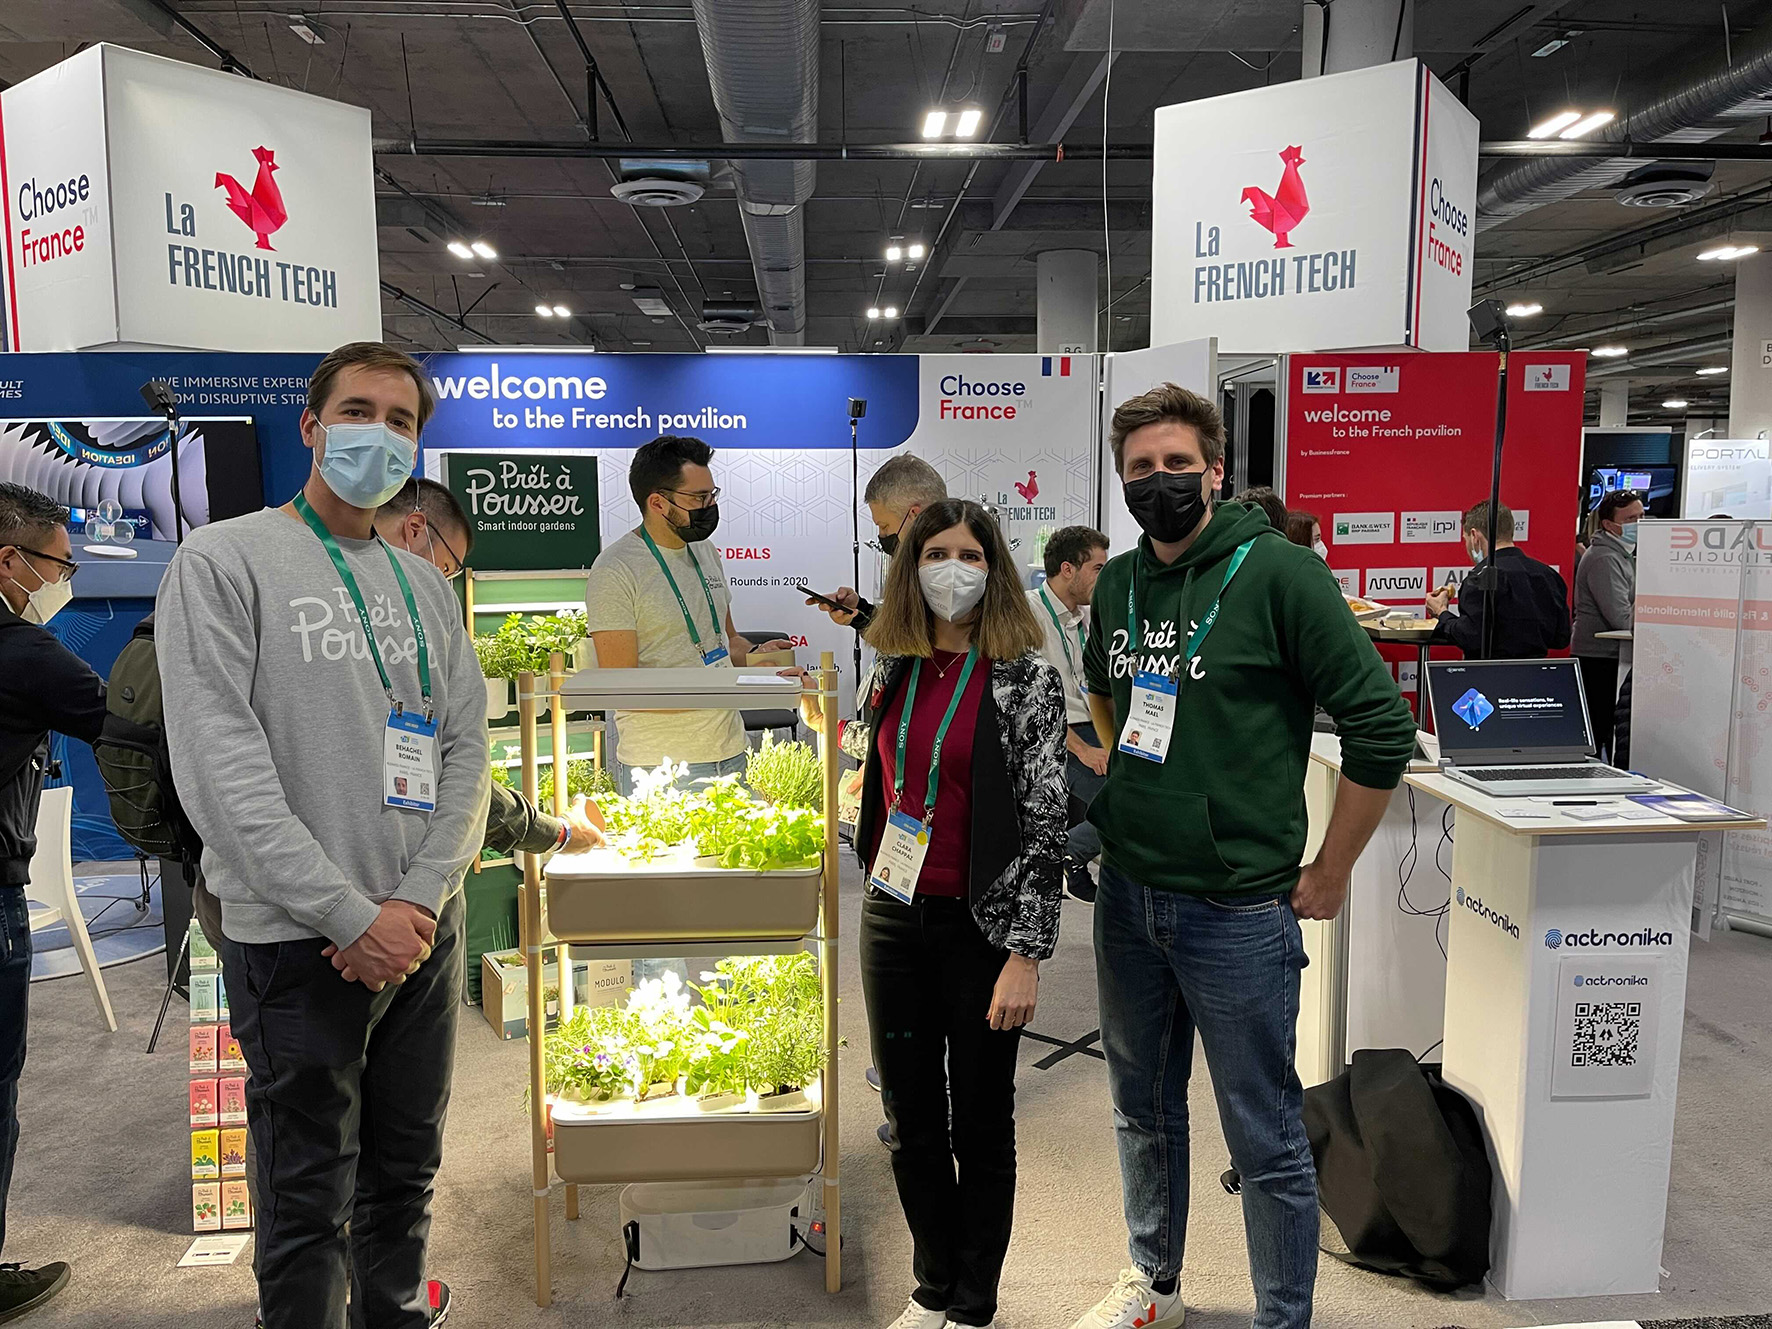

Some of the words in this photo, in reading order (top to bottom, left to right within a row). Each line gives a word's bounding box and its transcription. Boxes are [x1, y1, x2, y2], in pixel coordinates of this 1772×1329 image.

[19, 173, 90, 222] Choose
[1430, 177, 1468, 237] Choose
[165, 192, 196, 237] La
[21, 225, 85, 268] France
[1195, 221, 1220, 258] La
[1428, 221, 1462, 276] France
[168, 243, 272, 298] FRENCH
[276, 261, 338, 308] TECH
[1194, 258, 1286, 303] FRENCH
[1293, 249, 1356, 294] TECH
[184, 377, 259, 388] IMMERSIVE
[263, 377, 312, 388] EXPERI
[432, 363, 607, 400] welcome
[940, 375, 1026, 397] Choose
[199, 393, 277, 405] DISRUPTIVE
[281, 394, 309, 405] STA
[940, 399, 1016, 421] France
[493, 408, 518, 430] to
[524, 406, 565, 430] the
[571, 406, 651, 430] French
[658, 406, 747, 434] pavilion
[1304, 403, 1391, 422] welcome
[1333, 426, 1346, 437] to
[1349, 425, 1369, 437] the
[1372, 425, 1412, 437] French
[1415, 424, 1461, 439] pavilion
[1691, 449, 1766, 459] PORTAL
[555, 465, 573, 490] à
[465, 468, 584, 516] Pousser
[998, 492, 1008, 504] La
[1034, 507, 1056, 520] TECH
[477, 521, 505, 531] Smart
[508, 520, 537, 531] indoor
[540, 521, 576, 533] gardens
[1433, 520, 1455, 534] inpi
[726, 548, 771, 560] DEALS
[730, 576, 769, 587] Rounds
[771, 576, 780, 586] in
[783, 576, 808, 587] 2020
[1205, 599, 1220, 625] SON
[359, 608, 374, 641] SONY
[413, 617, 425, 648] SONY
[1142, 701, 1164, 712] THOMAS
[898, 721, 908, 750] SONY
[398, 752, 420, 763] ROMAIN
[932, 736, 942, 767] SONY
[1466, 894, 1520, 940] actronika
[1565, 928, 1673, 947] actronika
[594, 976, 625, 988] MODULO
[1585, 975, 1648, 986] actronika
